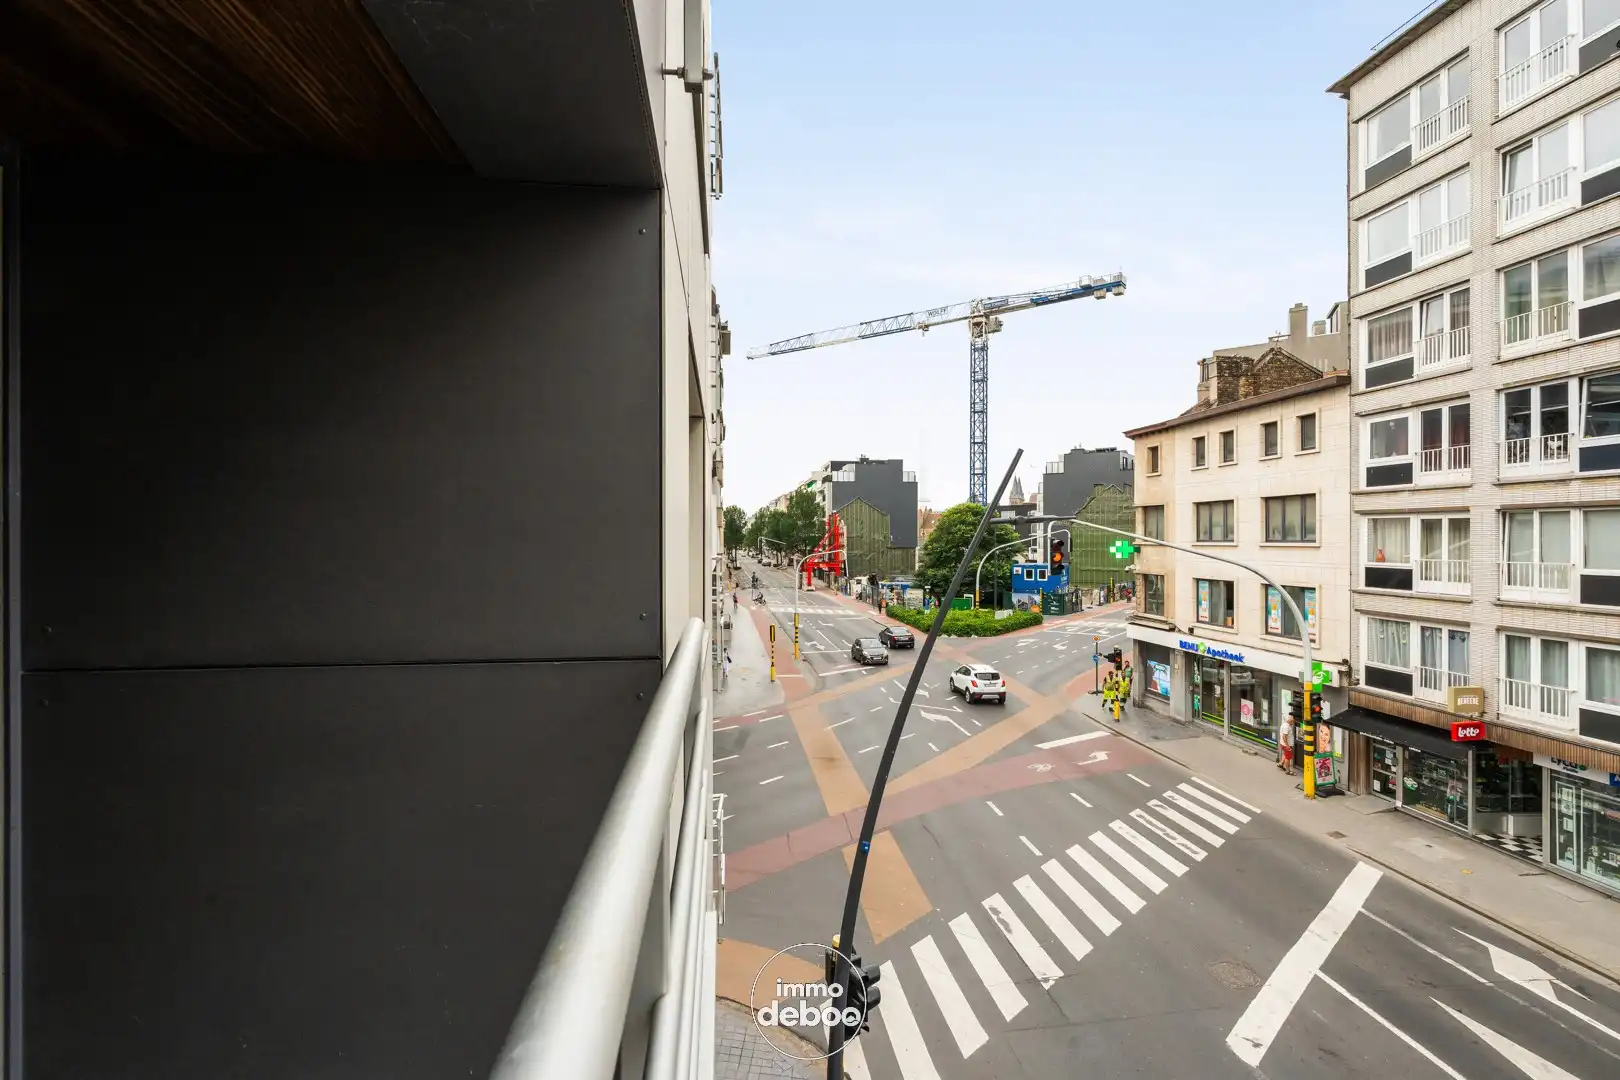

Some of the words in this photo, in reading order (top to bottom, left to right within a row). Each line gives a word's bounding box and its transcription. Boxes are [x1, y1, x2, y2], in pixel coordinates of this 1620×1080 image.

[927, 308, 948, 317] WOLFF
[1206, 647, 1245, 662] Apotheek
[1457, 727, 1480, 738] Lotto
